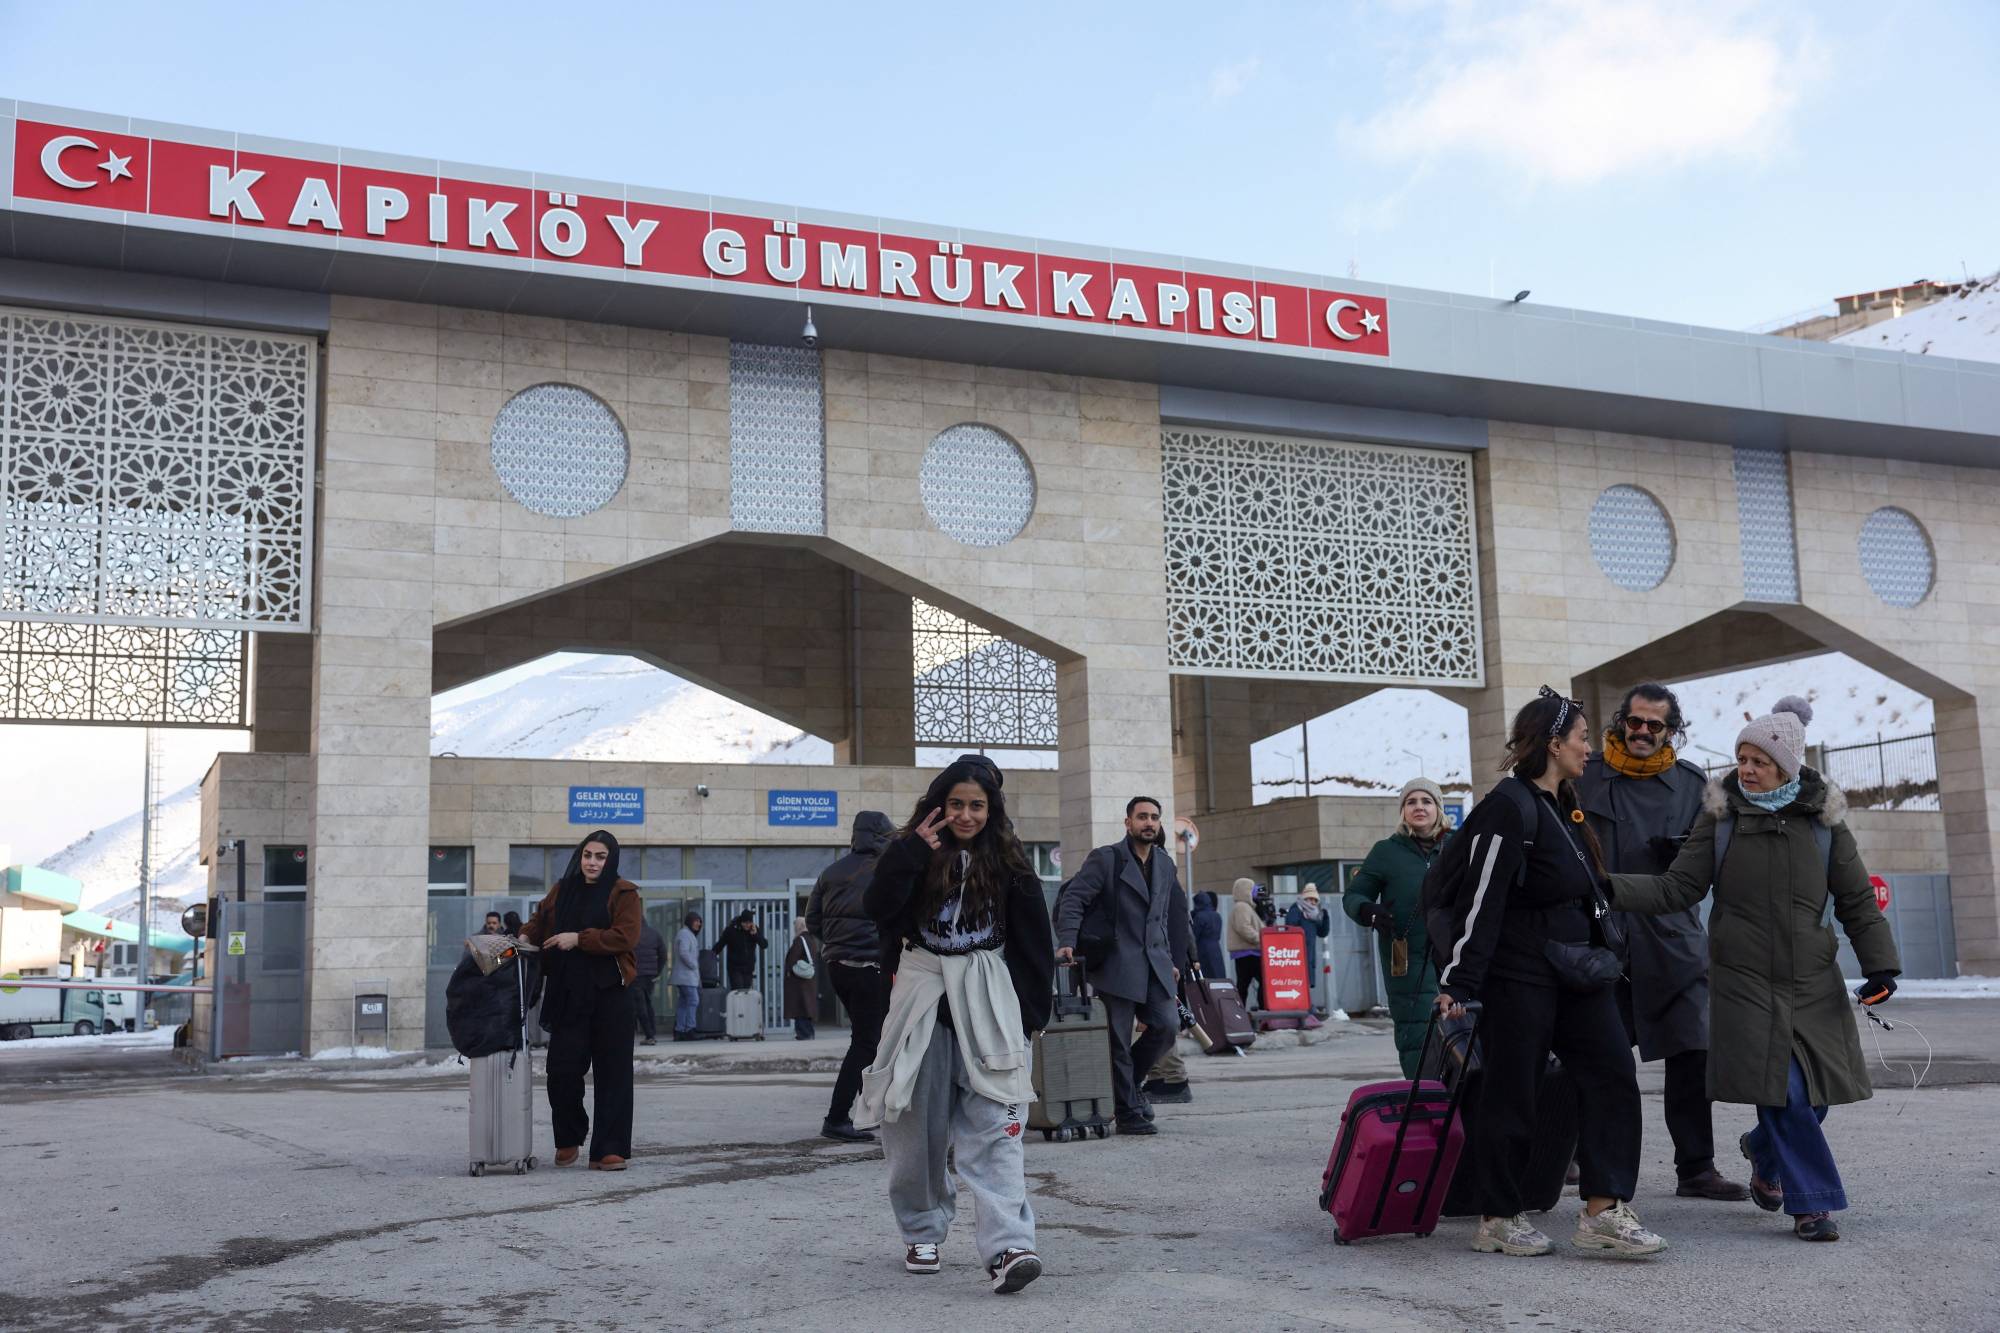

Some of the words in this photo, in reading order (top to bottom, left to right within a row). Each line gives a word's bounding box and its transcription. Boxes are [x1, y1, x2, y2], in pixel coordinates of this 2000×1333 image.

[209, 164, 660, 267] KAPIKÖY
[702, 221, 1026, 310] GÜMRÜK
[1053, 270, 1278, 340] KAPISI
[576, 791, 606, 801] GELEN
[608, 792, 638, 802] YOLCU
[776, 795, 802, 805] GİDEN
[803, 797, 830, 806] YOLCU
[603, 801, 641, 809] PASSENGERS
[1268, 945, 1300, 959] Setur
[1269, 959, 1302, 968] DutyFree
